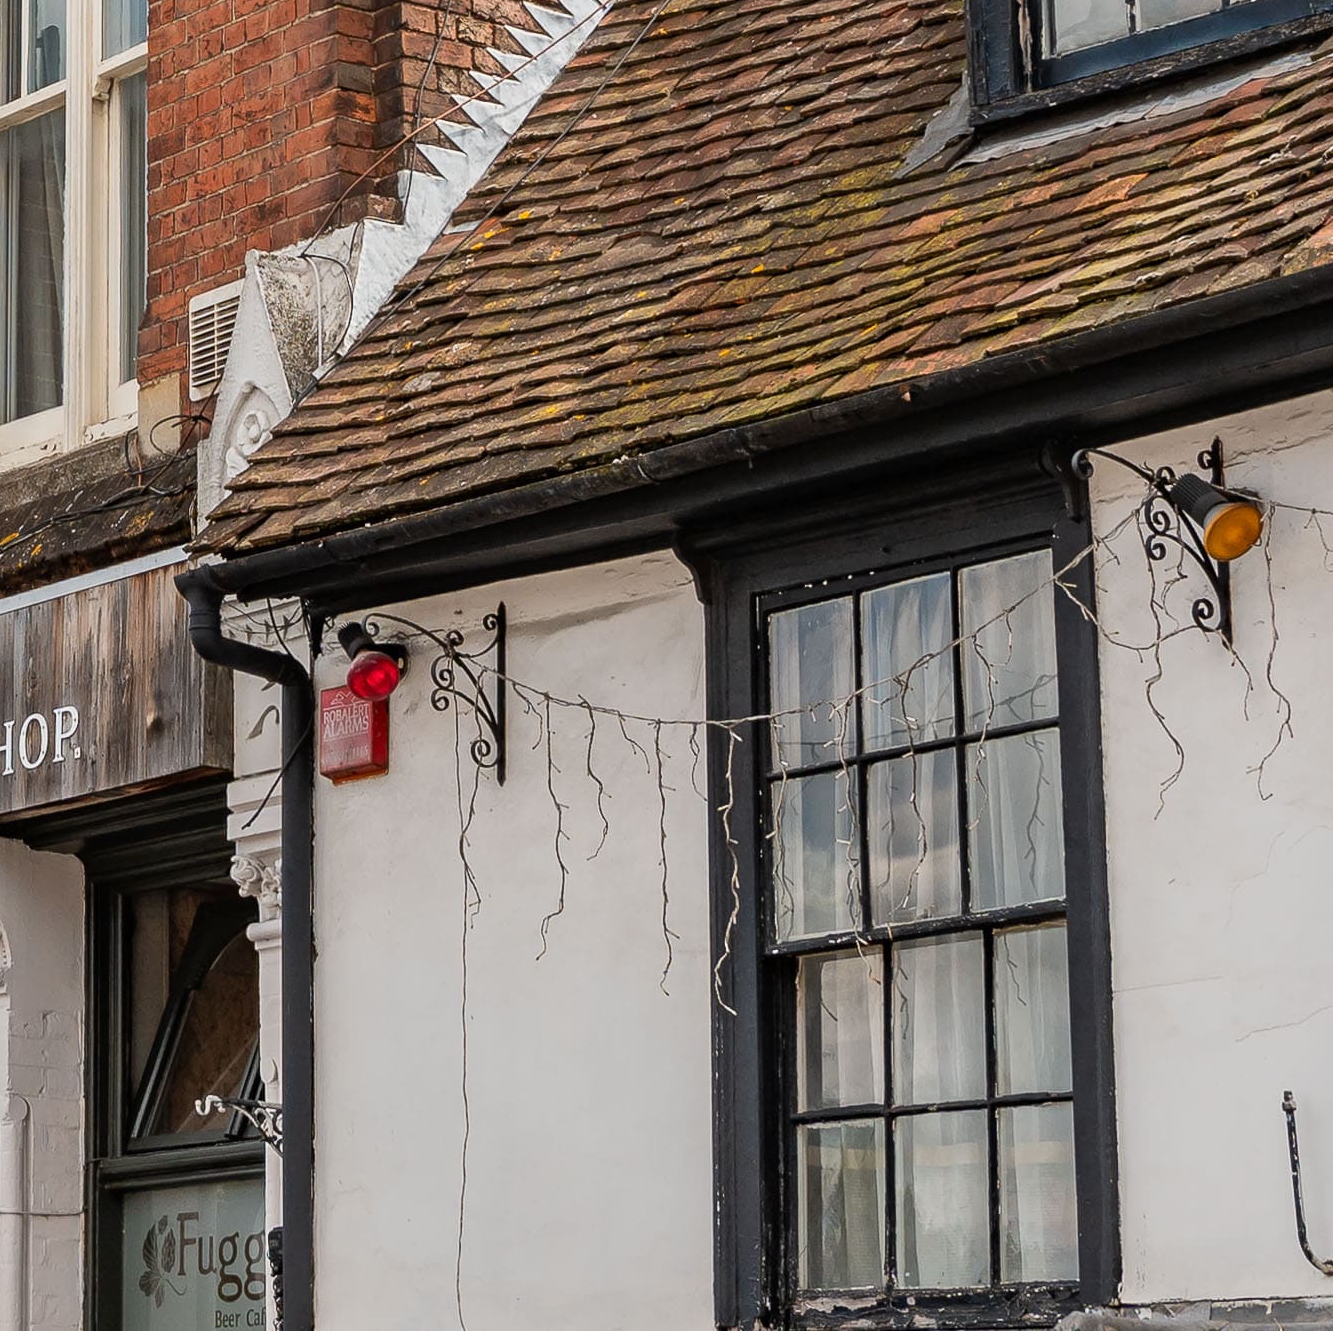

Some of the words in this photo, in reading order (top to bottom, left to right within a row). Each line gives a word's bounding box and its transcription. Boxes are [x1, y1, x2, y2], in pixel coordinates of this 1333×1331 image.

[323, 703, 369, 725] ROBALERT
[323, 716, 369, 740] ALARMS
[214, 1310, 242, 1328] Beer
